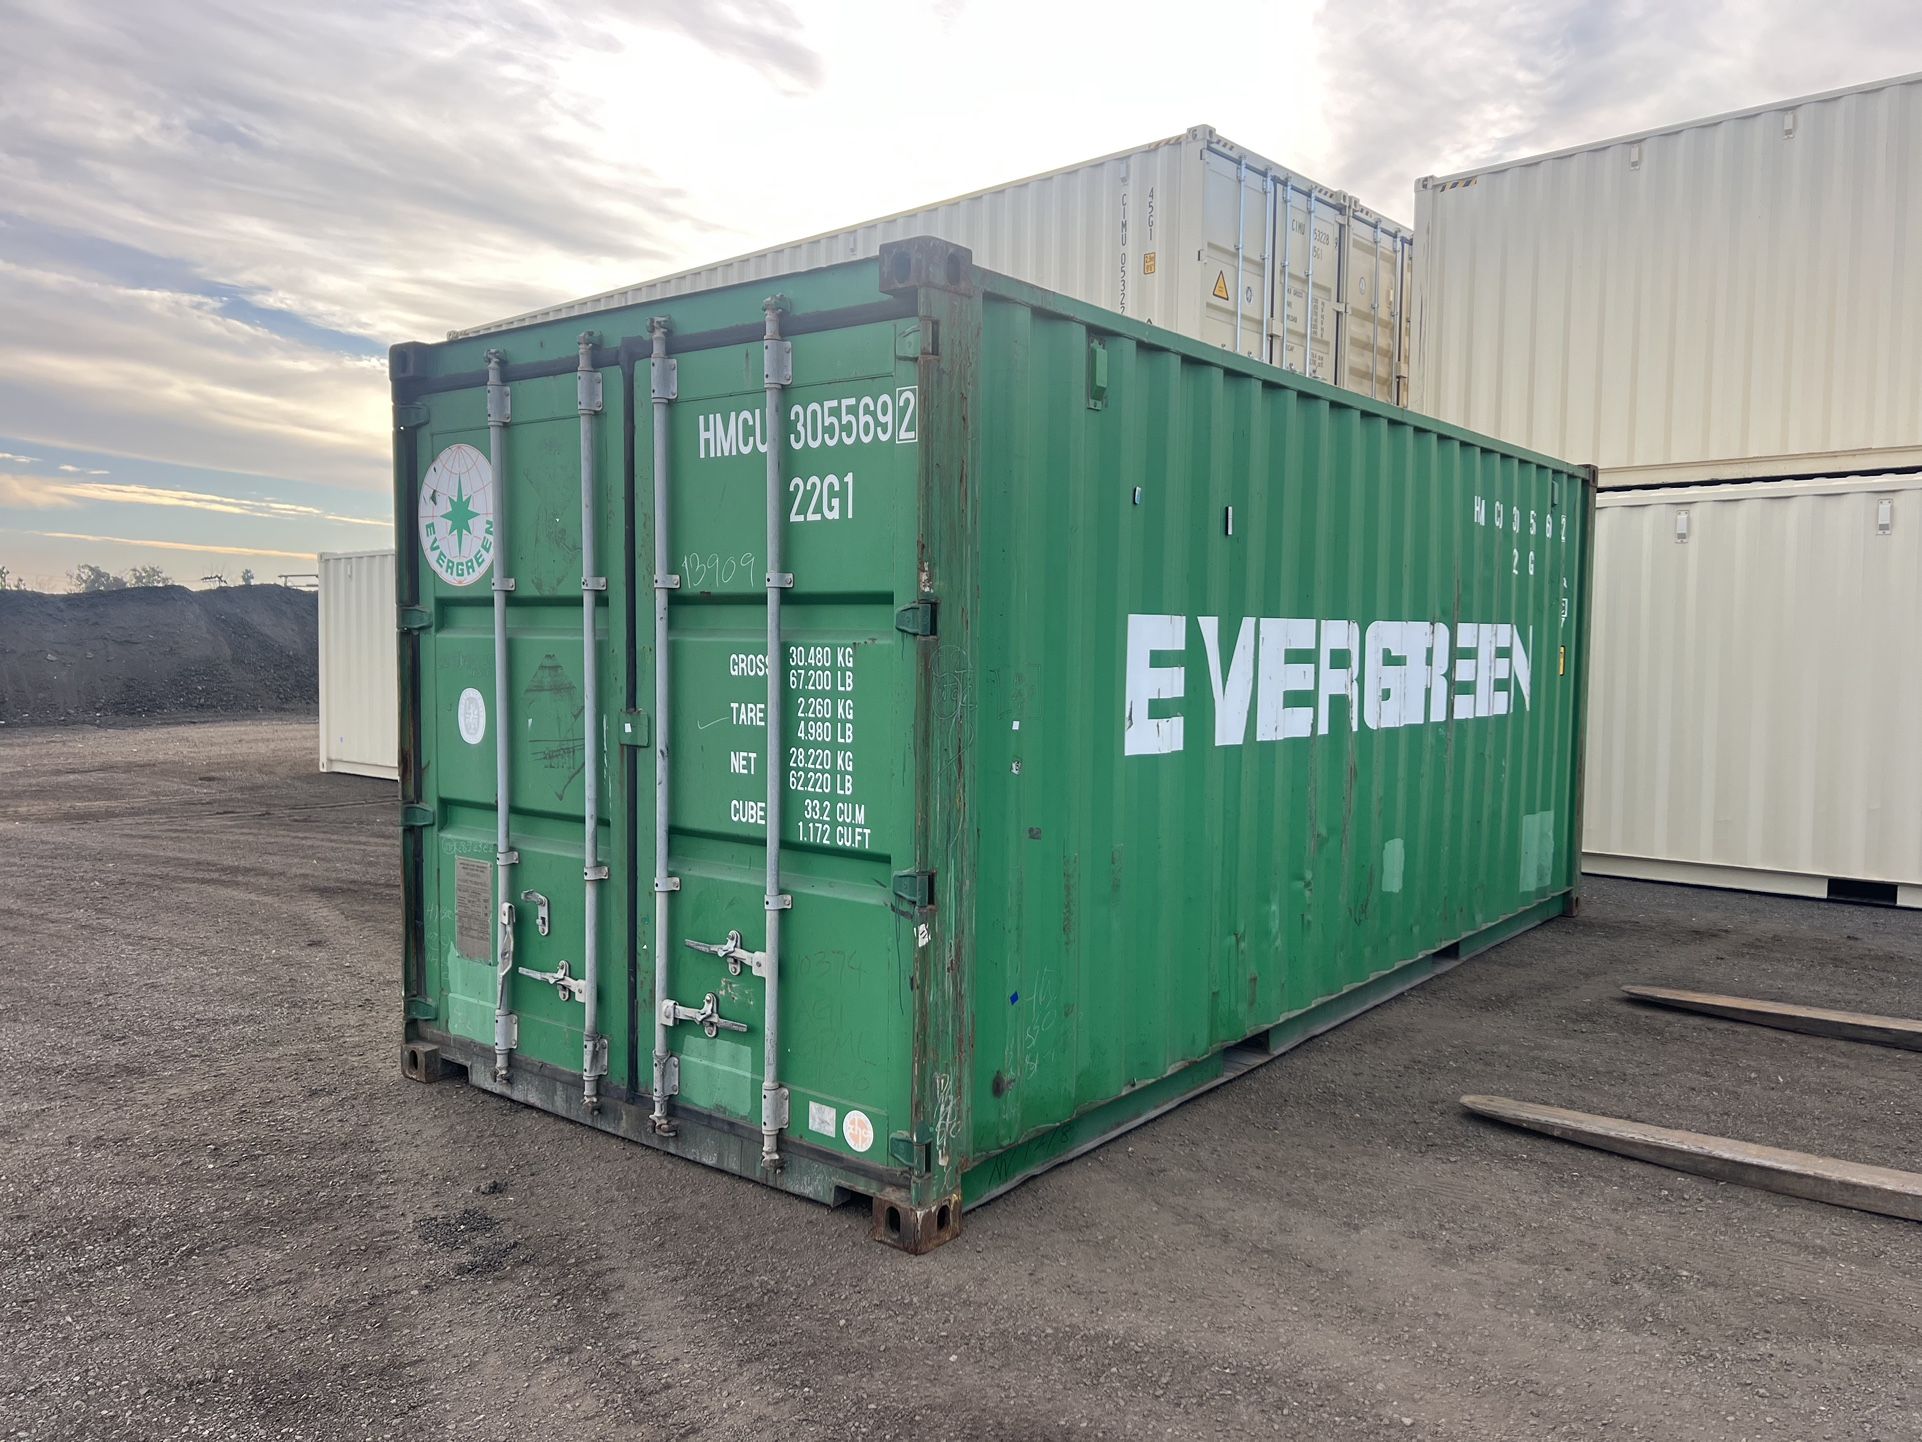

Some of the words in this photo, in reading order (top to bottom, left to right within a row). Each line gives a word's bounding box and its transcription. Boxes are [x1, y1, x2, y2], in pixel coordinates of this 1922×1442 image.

[699, 408, 767, 458] HMCU
[789, 472, 853, 522] 22G1
[425, 519, 494, 577] EVERGREEN
[789, 646, 831, 667] 30.480
[837, 647, 854, 668] KG
[789, 669, 831, 691] 67.200
[837, 671, 853, 692] LB
[1124, 614, 1533, 756] EVERGREEN
[730, 702, 765, 726] TARE
[797, 697, 831, 718] 2.260
[837, 699, 854, 720] KG
[797, 720, 831, 742] 4.980
[837, 722, 853, 743] LB
[730, 751, 757, 774] NET
[789, 747, 831, 769] 28.220
[837, 751, 853, 771] KG
[789, 770, 831, 793] 62.220
[837, 773, 852, 795] LB
[730, 799, 766, 824] CUBE
[804, 799, 831, 821] 33.2
[836, 802, 865, 825] CU.M
[798, 821, 831, 844] 1.172
[836, 828, 871, 849] CU.FT
